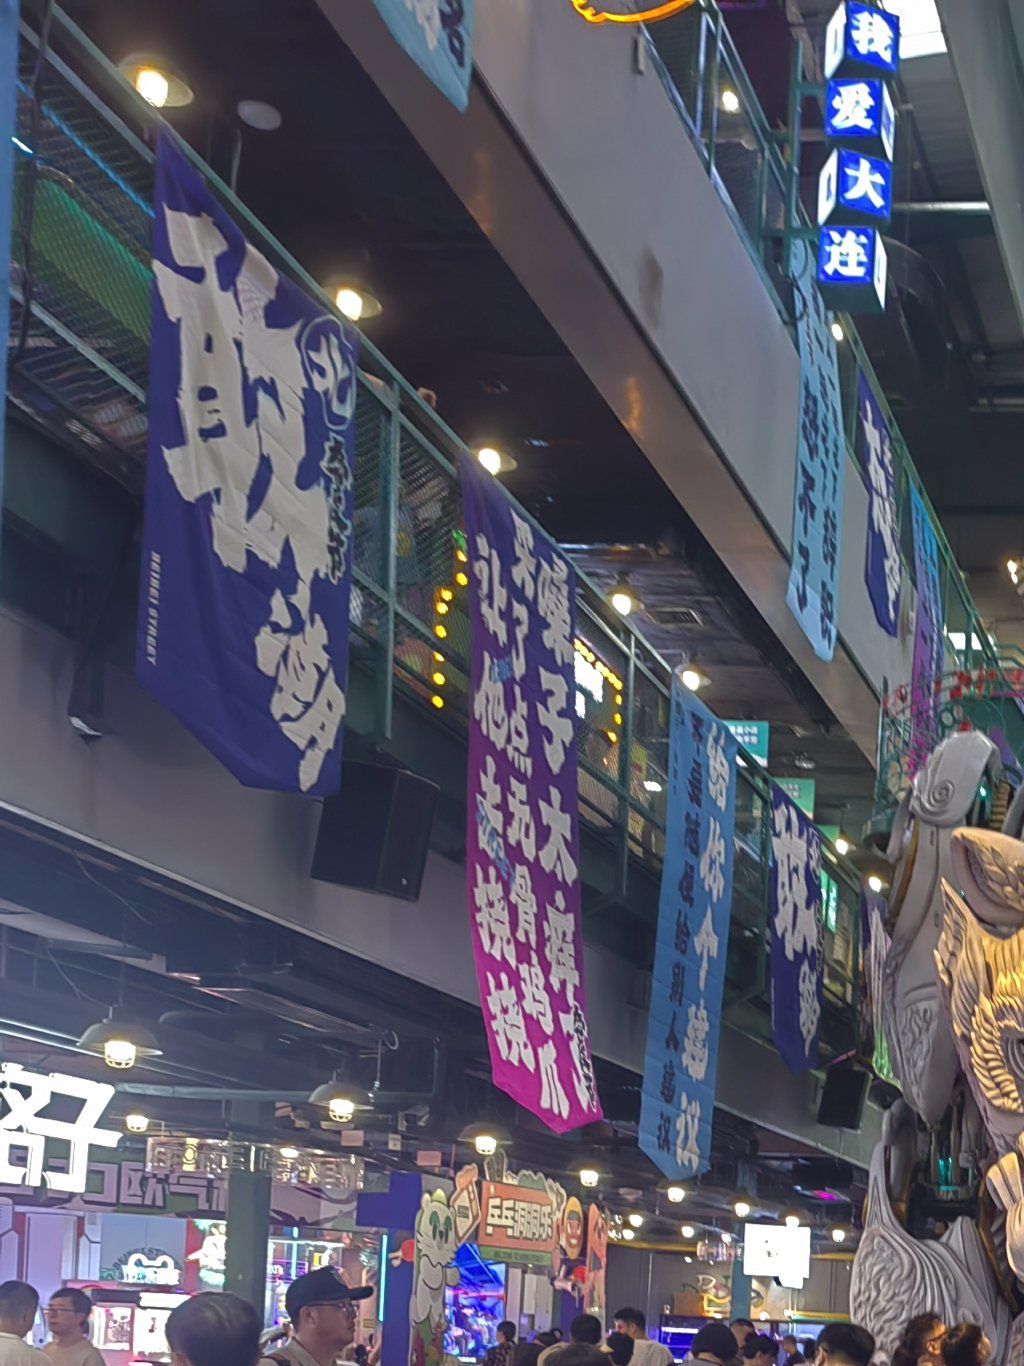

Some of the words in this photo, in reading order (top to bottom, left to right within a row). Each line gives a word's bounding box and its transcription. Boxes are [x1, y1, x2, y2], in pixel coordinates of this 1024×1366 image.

[822, 11, 894, 277] 我爱大连
[486, 1196, 553, 1242] 乒乓洞洞乐
